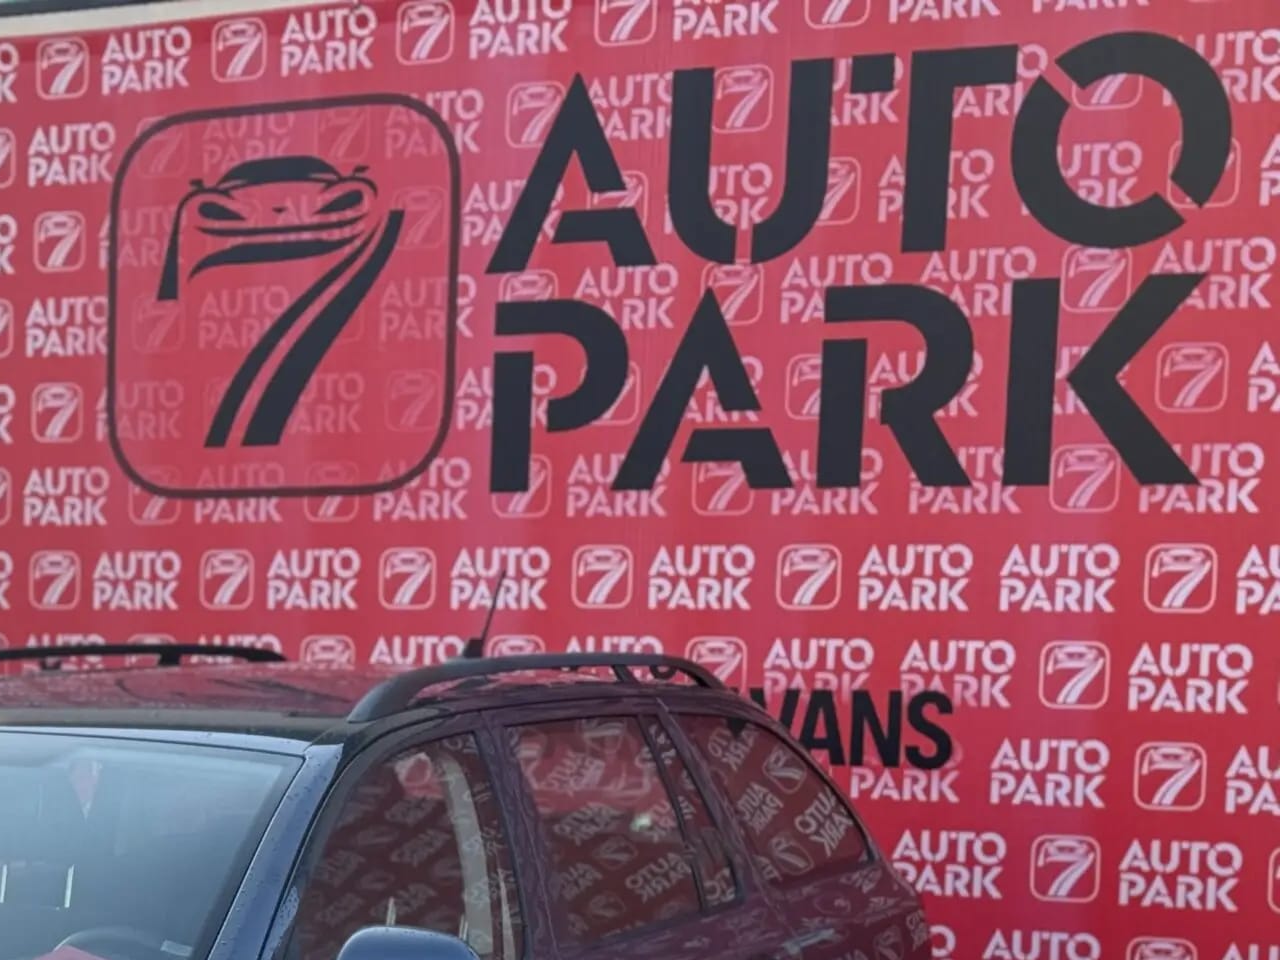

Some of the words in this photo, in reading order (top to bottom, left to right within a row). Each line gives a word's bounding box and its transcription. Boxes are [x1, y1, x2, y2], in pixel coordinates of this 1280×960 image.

[281, 6, 376, 44] AUTO
[673, 1, 778, 42] PARK
[101, 27, 191, 63] AUTO
[282, 37, 373, 76] PARK
[469, 20, 569, 60] PARK
[102, 57, 188, 95] PARK
[28, 122, 116, 157] AUTO
[485, 31, 1232, 274] AUTO
[29, 152, 113, 187] PARK
[781, 252, 894, 289] AUTO
[921, 246, 1037, 283] AUTO
[1151, 236, 1277, 275] AUTO
[575, 263, 680, 299] AUTO
[26, 296, 108, 327] AUTO
[26, 325, 107, 357] PARK
[490, 272, 1211, 492] PARK
[24, 467, 109, 496] AUTO
[771, 482, 879, 515] PARK
[908, 481, 1021, 514] PARK
[1138, 478, 1261, 513] PARK
[24, 496, 106, 525] PARK
[194, 496, 283, 524] PARK
[372, 489, 468, 522] PARK
[567, 485, 668, 518] PARK
[93, 551, 181, 580] AUTO
[267, 548, 360, 578] AUTO
[451, 547, 550, 578] AUTO
[649, 545, 755, 576] AUTO
[859, 544, 973, 576] AUTO
[1000, 544, 1119, 577] AUTO
[93, 580, 177, 610] PARK
[268, 578, 356, 609] PARK
[451, 578, 546, 610] PARK
[648, 577, 750, 609] PARK
[859, 577, 968, 611] PARK
[1000, 578, 1115, 612] PARK
[370, 636, 465, 665] AUTO
[764, 638, 874, 670] AUTO
[901, 640, 1015, 673] AUTO
[1129, 643, 1252, 678] AUTO
[1128, 677, 1248, 713] PARK
[991, 739, 1109, 773] AUTO
[850, 767, 960, 803] PARK
[990, 772, 1104, 808] PARK
[892, 830, 1006, 864] AUTO
[1119, 840, 1242, 876] AUTO
[1119, 872, 1237, 911] PARK
